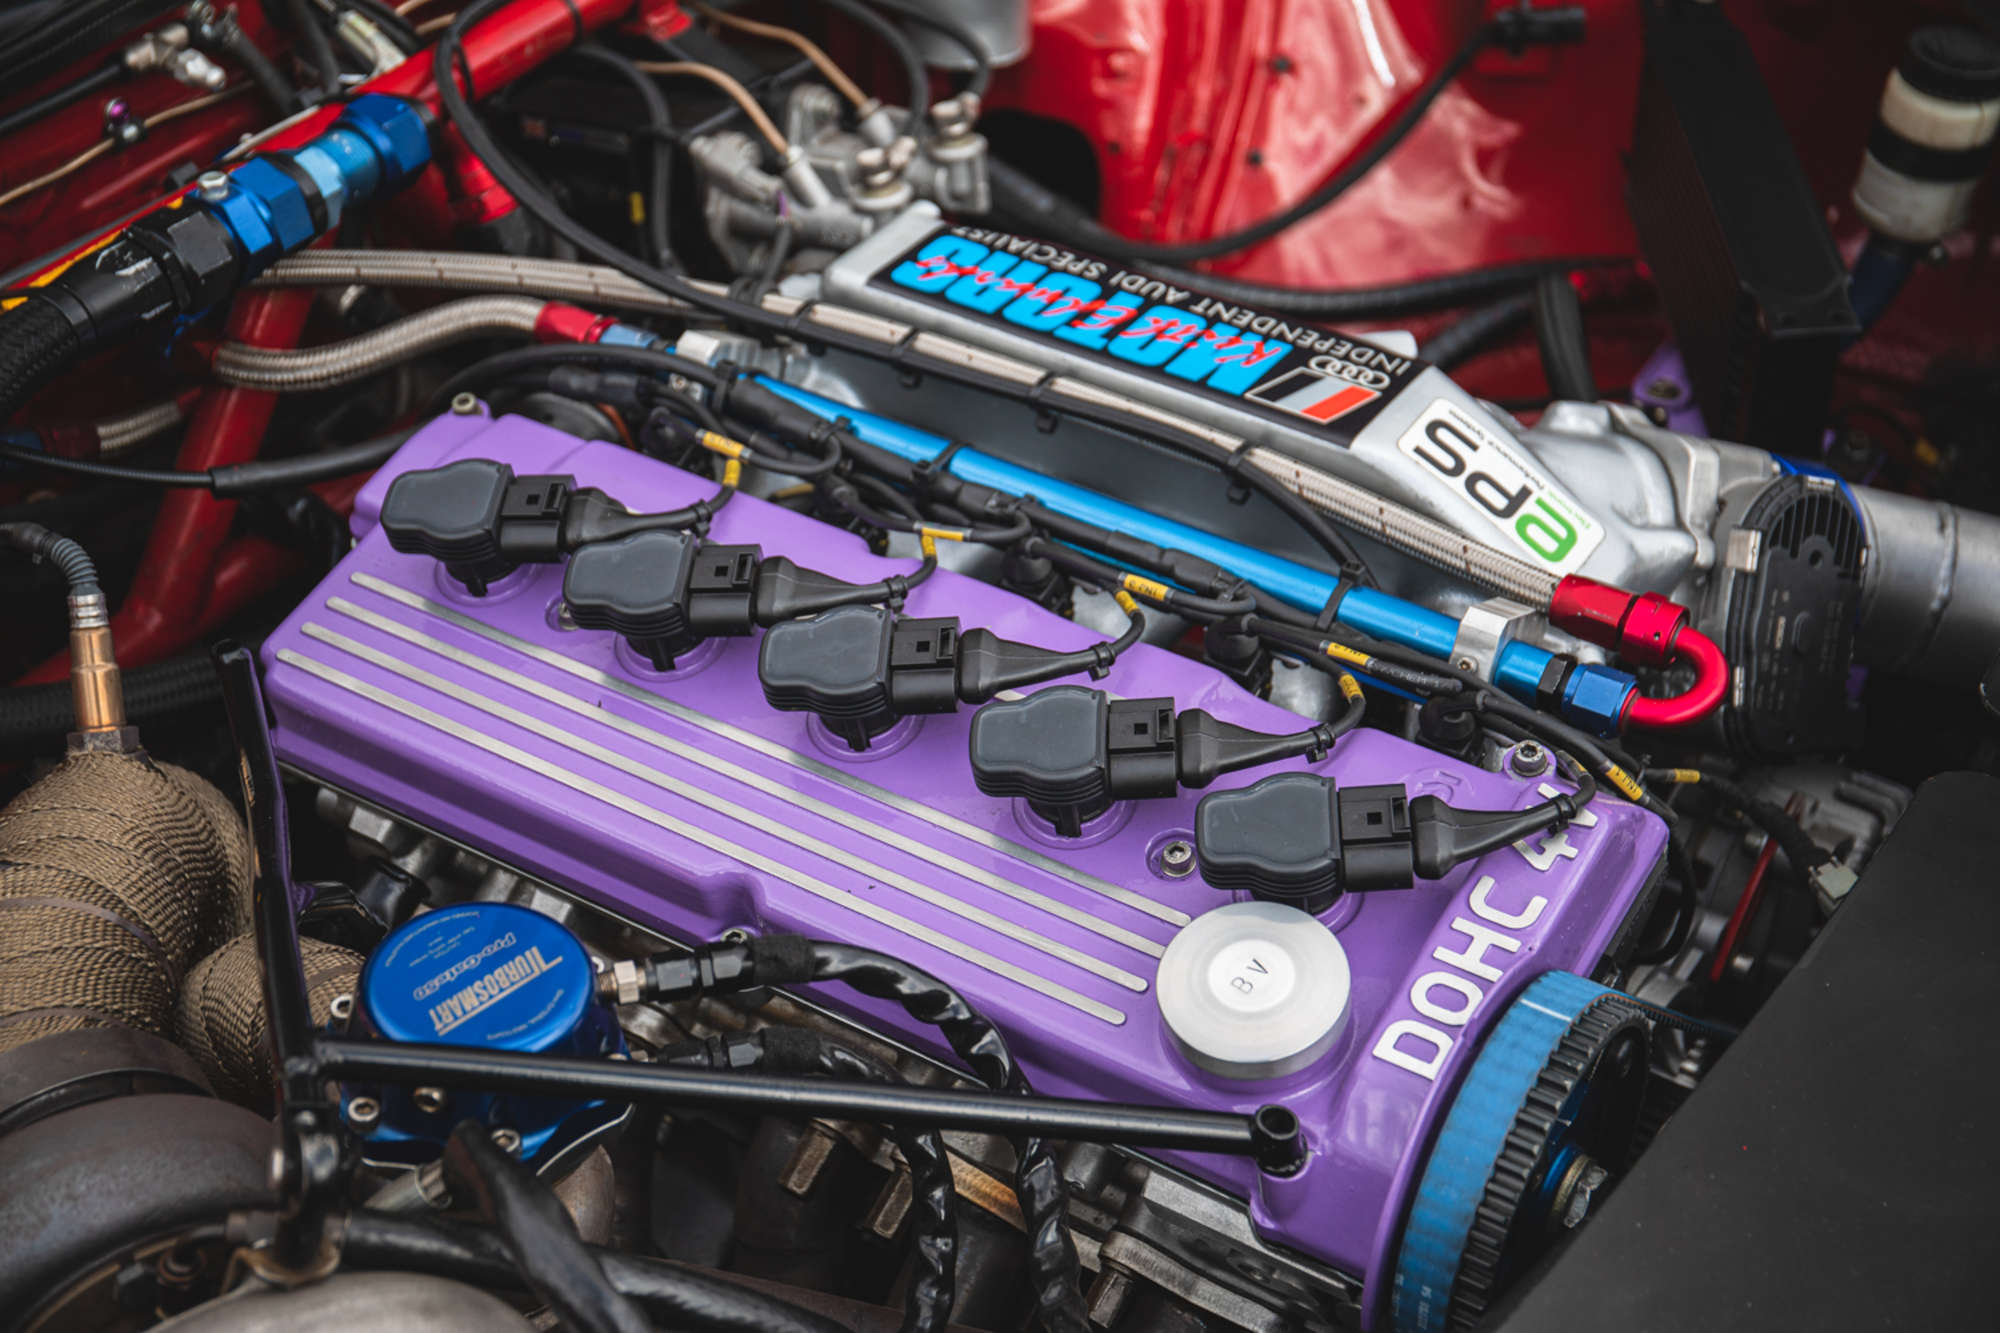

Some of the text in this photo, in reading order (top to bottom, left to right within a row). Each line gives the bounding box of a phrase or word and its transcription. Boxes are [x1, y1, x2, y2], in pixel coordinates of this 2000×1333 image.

[890, 234, 1294, 396] MOTORS
[951, 226, 1411, 376] INDEPENDENT AUDI SPECIALIST
[429, 946, 563, 1036] TURBOSMART
[1372, 875, 1548, 1081] DOHC
